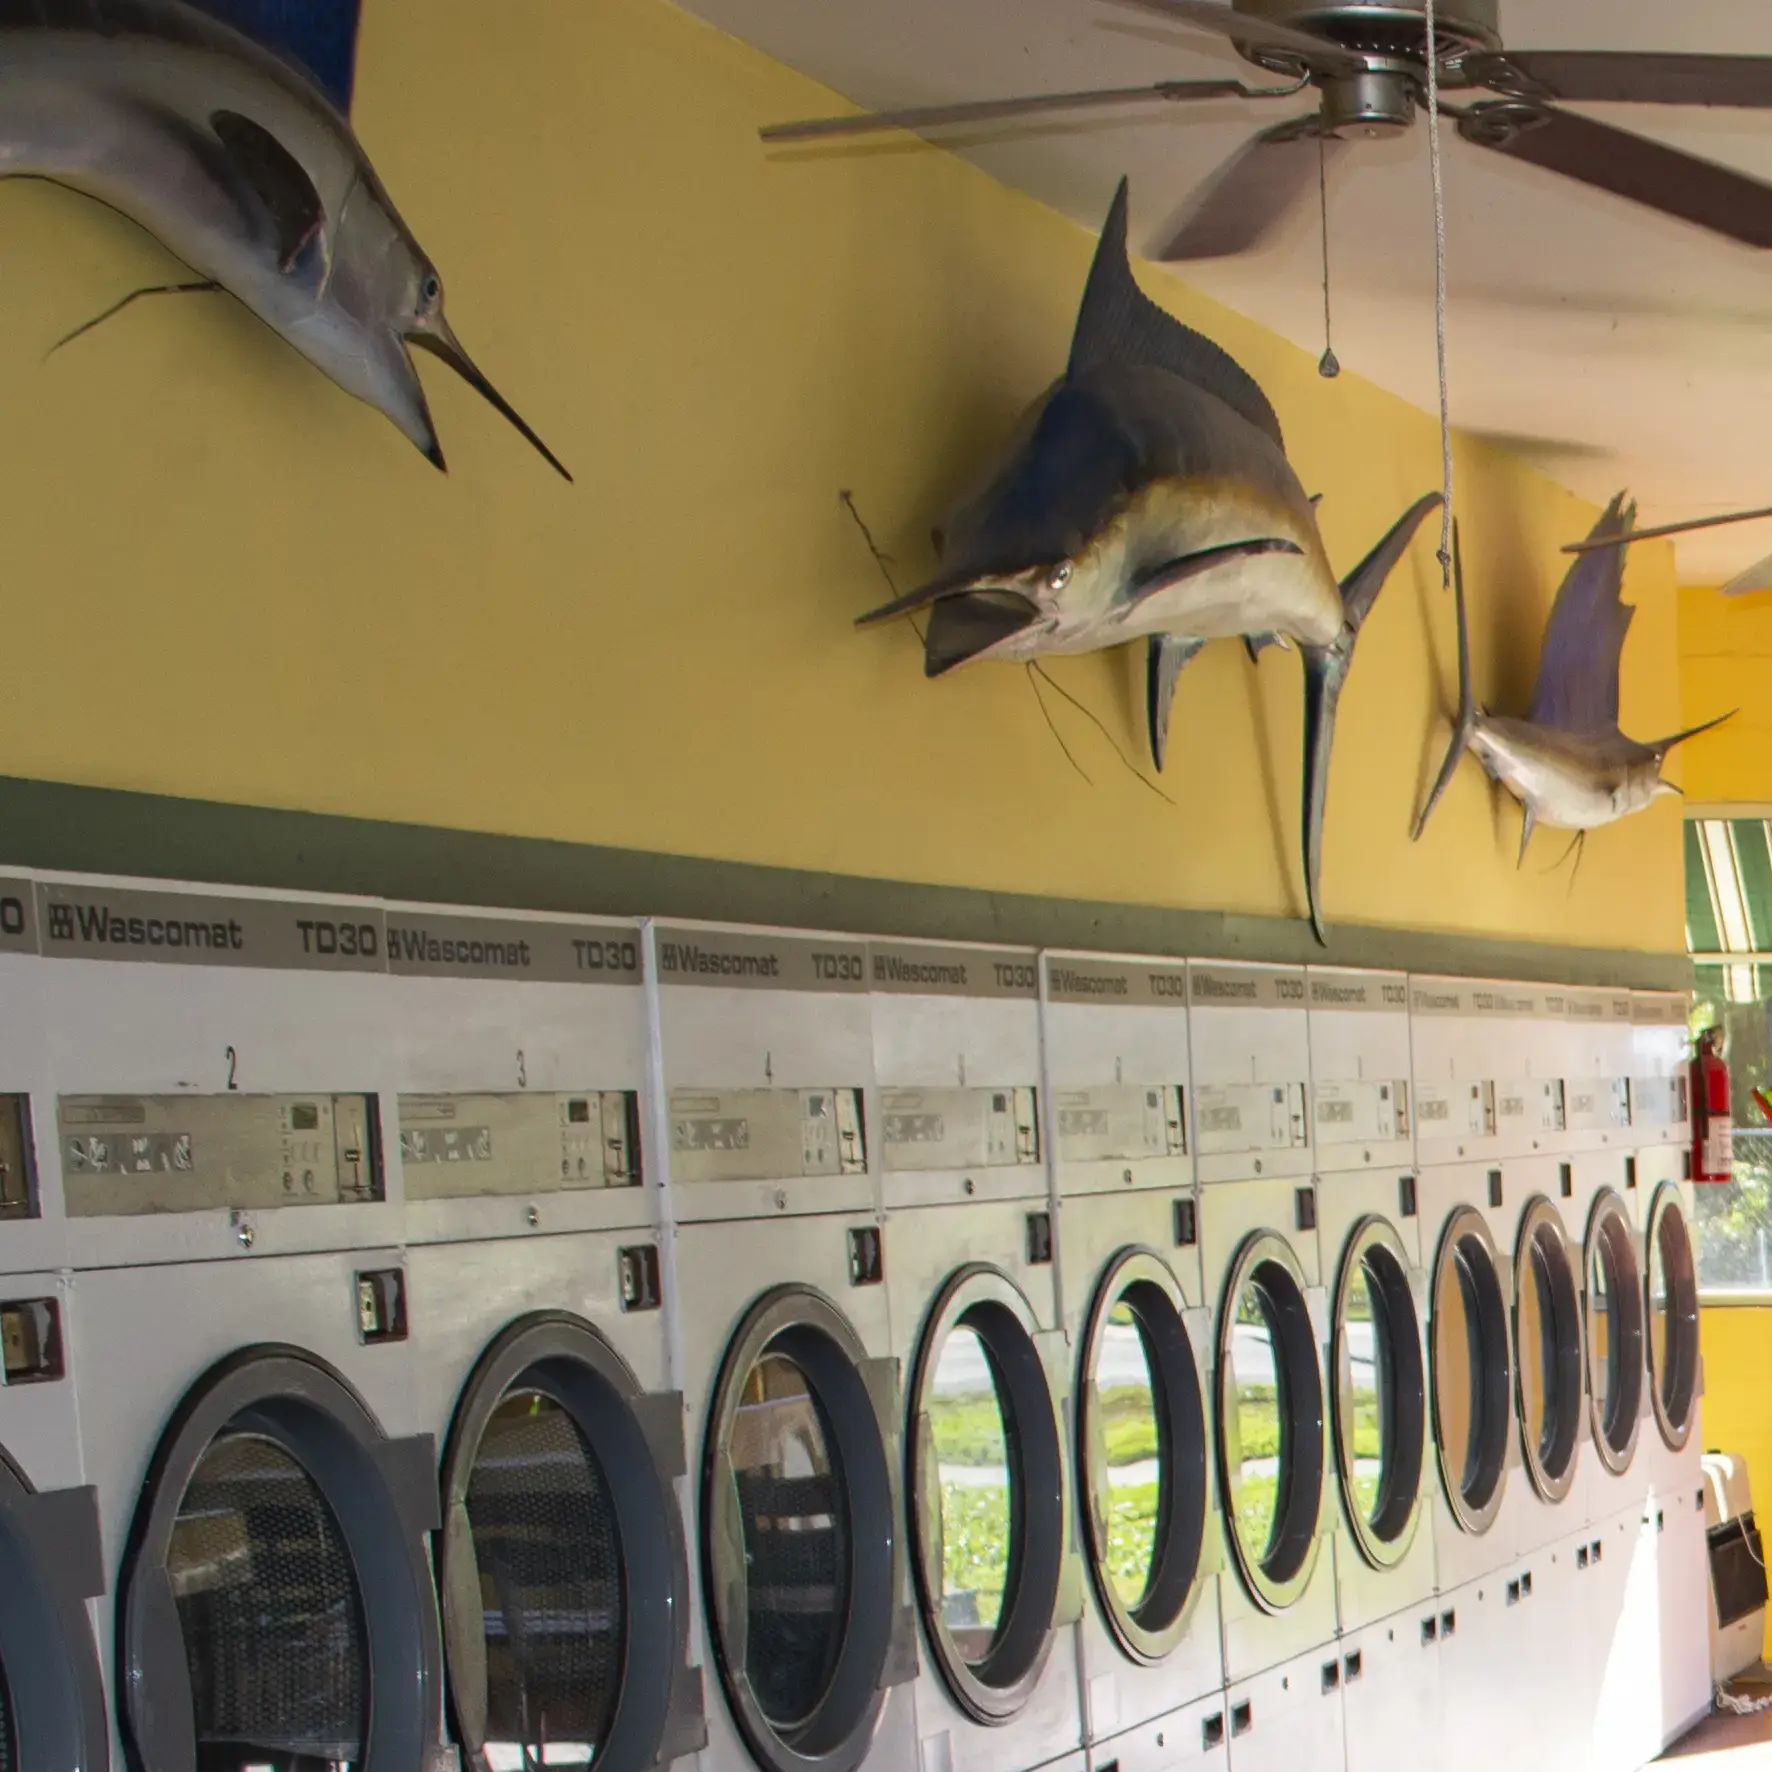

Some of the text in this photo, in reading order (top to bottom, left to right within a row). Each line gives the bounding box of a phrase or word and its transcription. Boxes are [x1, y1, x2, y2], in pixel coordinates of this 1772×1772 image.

[76, 905, 378, 957] Wascomat TD30
[402, 929, 637, 970] Wascomat TD30
[678, 946, 779, 977] Wascomat
[886, 955, 968, 985] Wascomat
[1061, 969, 1128, 996] Wascomat
[1199, 976, 1257, 1000] Wascomat
[226, 1045, 238, 1090] 2
[516, 1049, 527, 1088] 3
